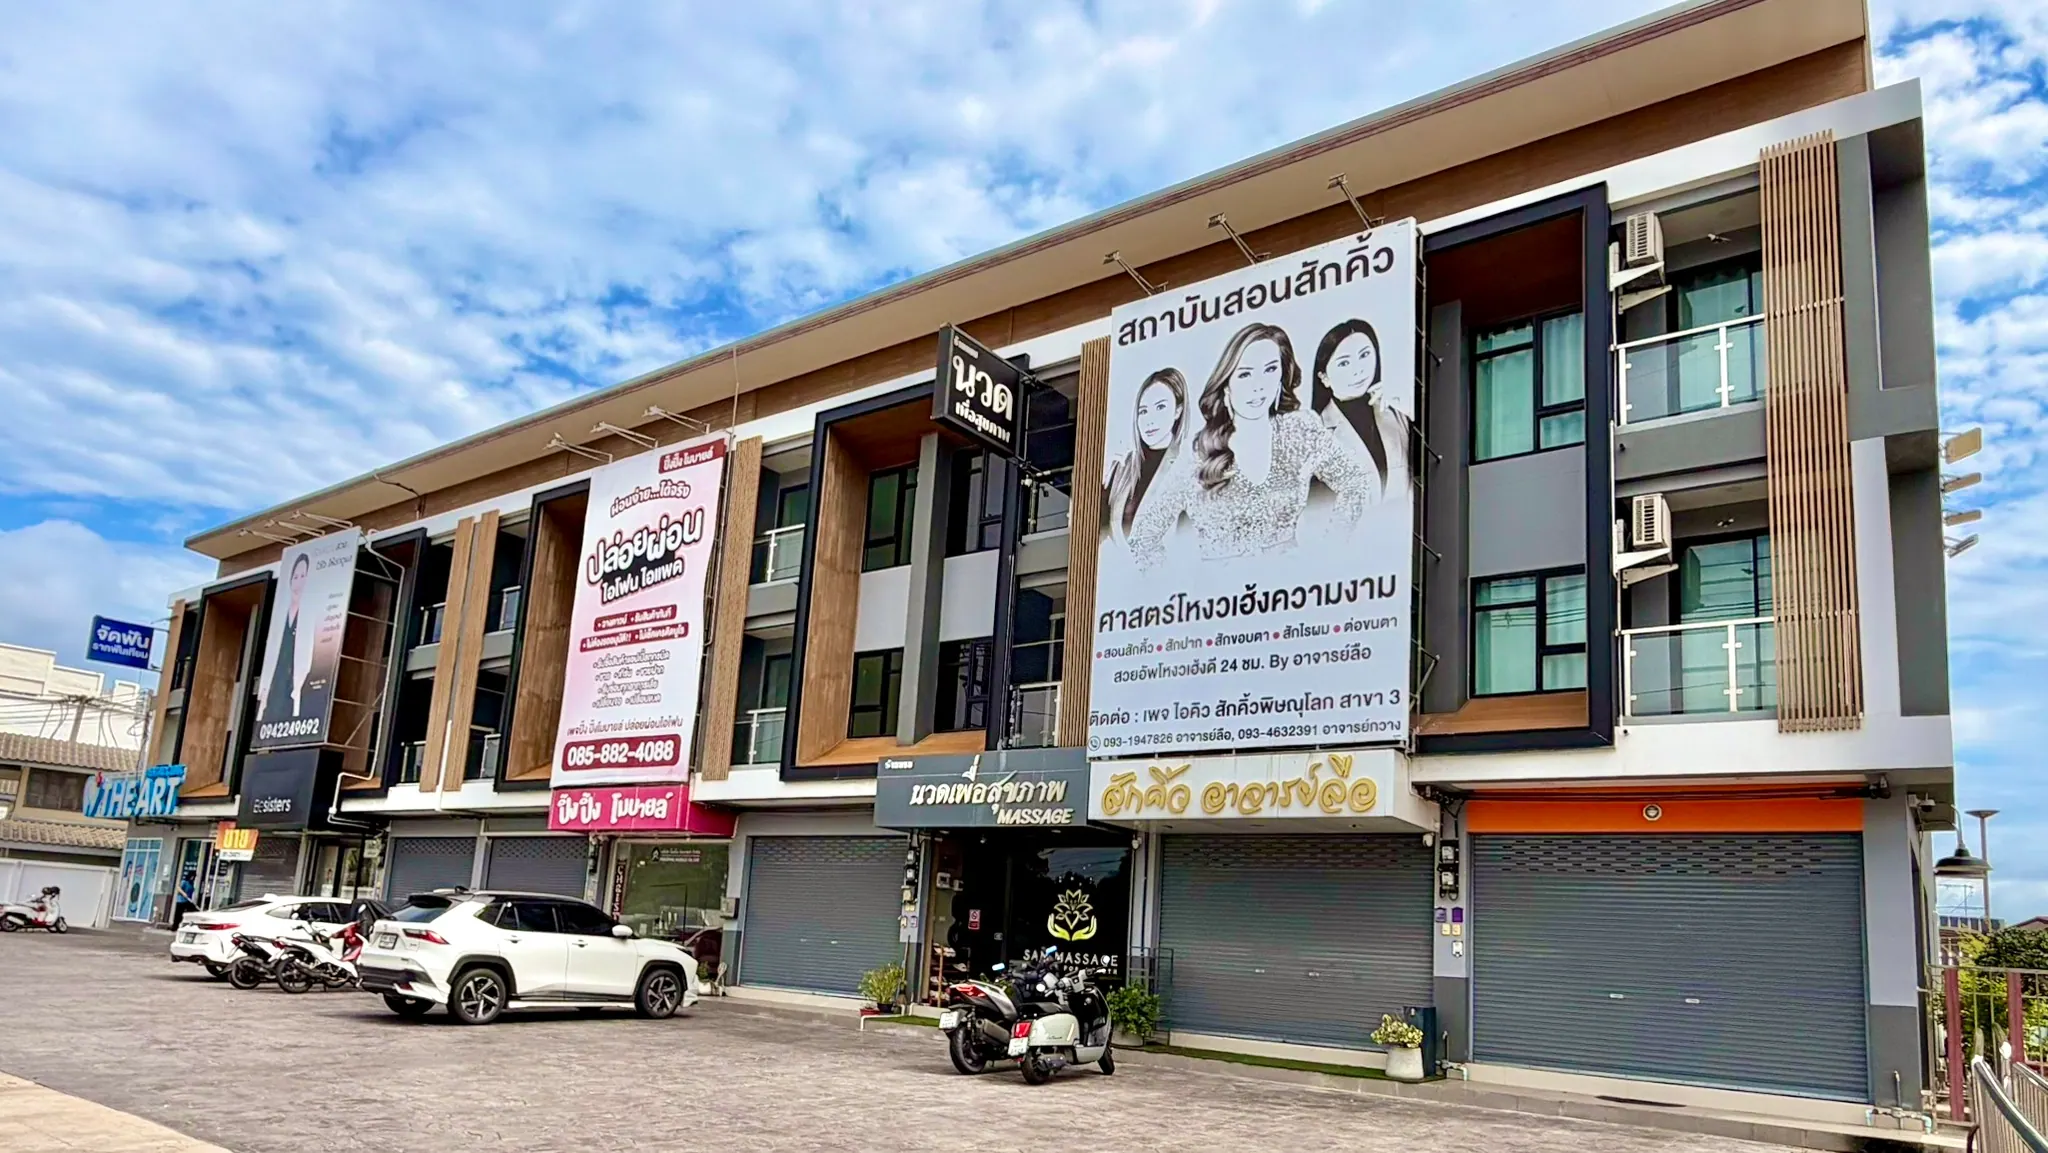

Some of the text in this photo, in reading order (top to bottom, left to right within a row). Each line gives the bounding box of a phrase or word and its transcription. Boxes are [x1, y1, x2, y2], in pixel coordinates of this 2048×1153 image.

[1117, 232, 1395, 347] สถาบันสอนสักคิ้ว
[952, 354, 1014, 421] นวด
[955, 398, 1011, 443] เพื่อสุขภาพ
[587, 507, 704, 585] ปล่อยผ่อน
[602, 558, 684, 604] ไอโฟน ไอแพด
[1098, 573, 1397, 633] ศาสตร์โหงวเฮ้งความงาม
[96, 624, 151, 649] จัดฟัน
[1103, 614, 1398, 660] สอนสักคิ้ว สักปาก สักขอบตา สักไรผม ต่อขนตา
[1113, 656, 1217, 684] สวยอัพโหงวเฮ้งดี
[1220, 660, 1239, 673] 24
[1269, 653, 1288, 672] By
[1293, 642, 1373, 668] อาจารย์ลือ
[260, 718, 320, 740] 0942249692
[1089, 705, 1130, 727] ติดต่อ
[1142, 706, 1169, 724] เพจ
[1173, 701, 1211, 720] ไอคิว
[1215, 692, 1334, 719] สักคิ้วพิษณุโลก
[1340, 692, 1384, 709] สาขา
[1389, 689, 1401, 705] 3
[567, 739, 675, 767] 085-882-4088
[1103, 718, 1401, 748] 093-1947826 อาจารย์ลือ, 093-4632391 อาจารย์กวาง
[909, 754, 1068, 815] นวดเพื่อสุขภาพ
[1101, 753, 1378, 816] สักคิ้ว อาจารย์ลือ
[609, 791, 674, 824] โมบายล์
[997, 808, 1074, 826] MASSAGE
